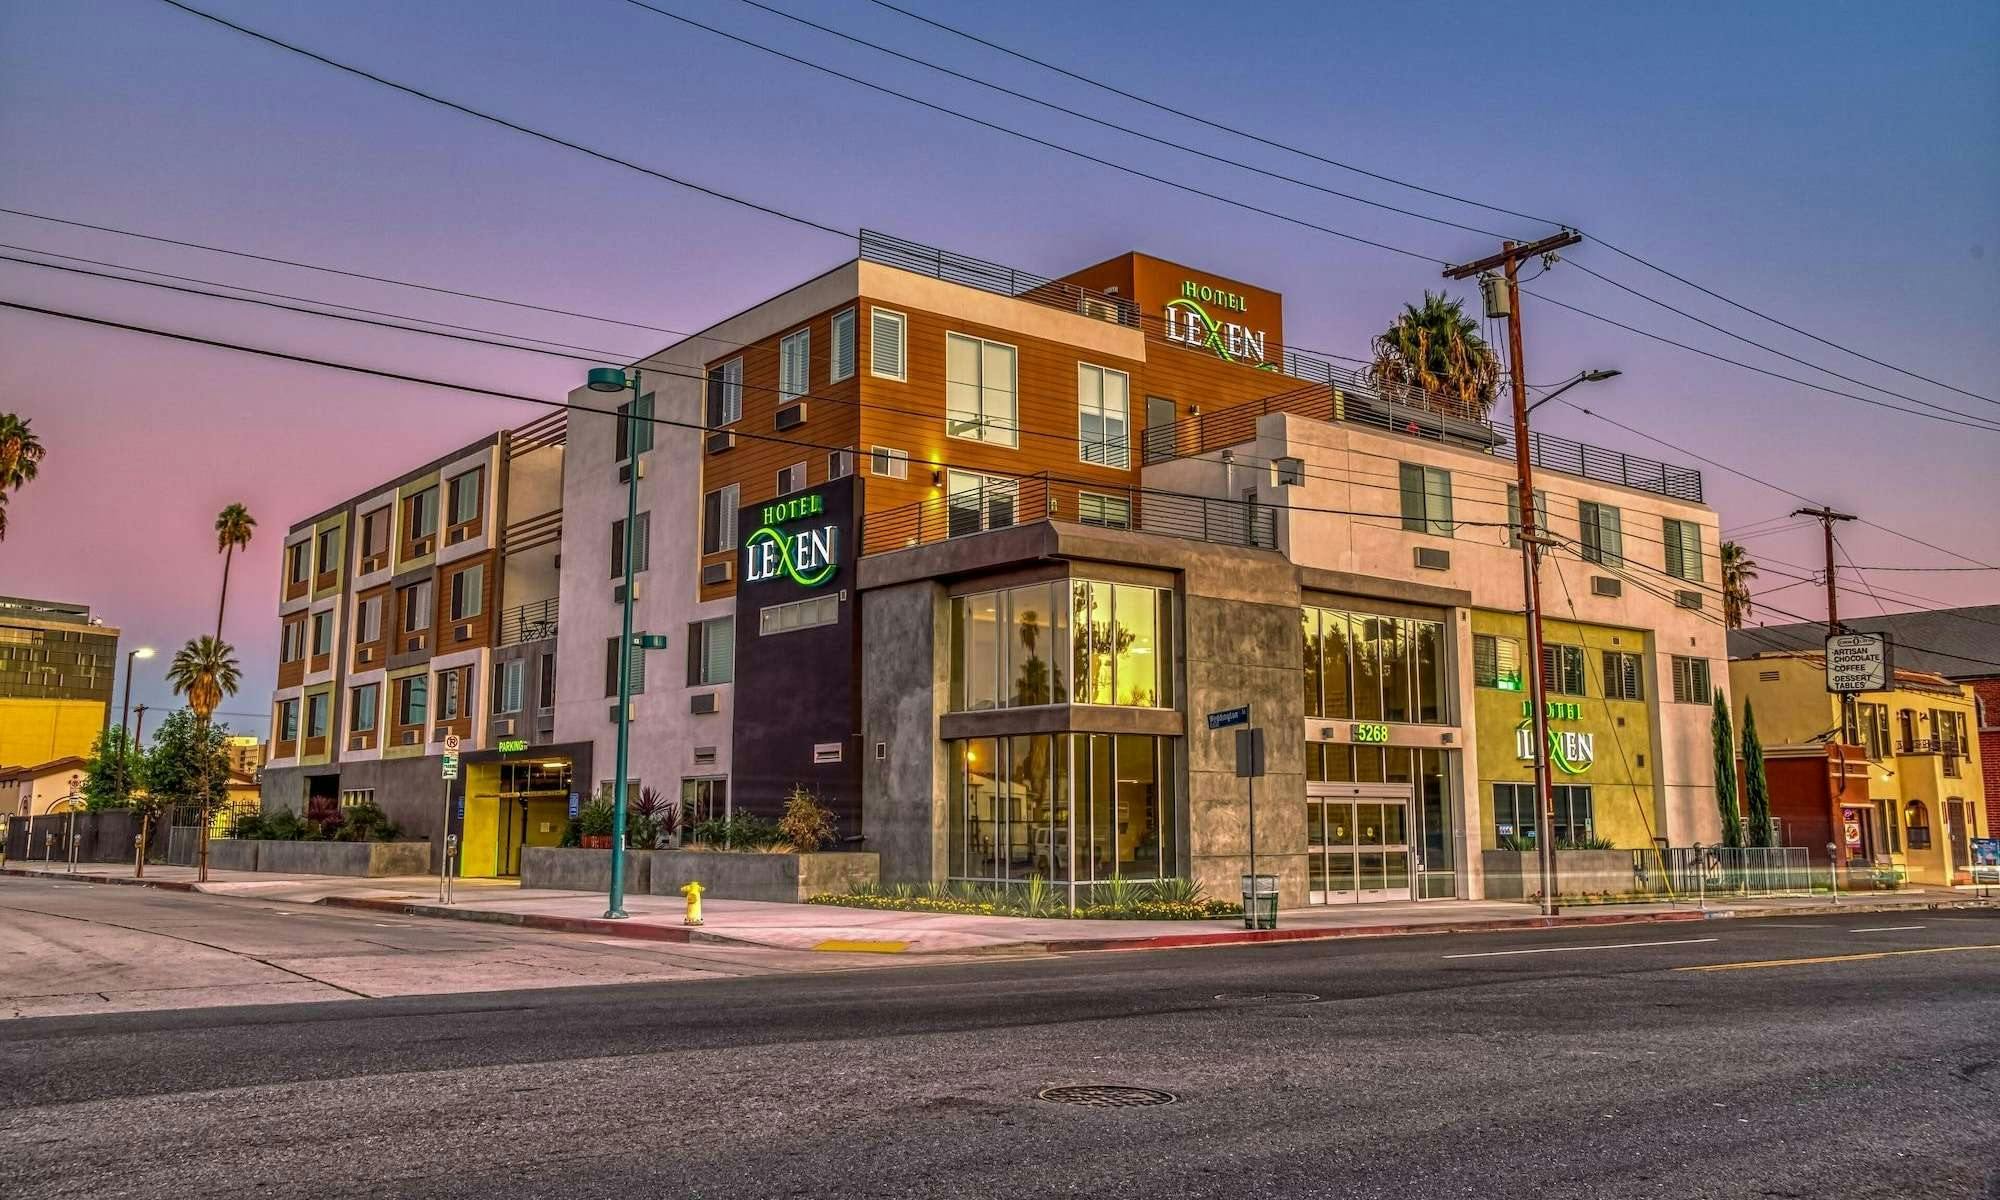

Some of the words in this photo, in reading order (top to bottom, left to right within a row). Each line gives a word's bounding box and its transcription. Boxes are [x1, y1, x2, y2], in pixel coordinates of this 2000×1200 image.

[1182, 280, 1248, 312] HOTEL
[1165, 299, 1266, 362] LEXEN
[764, 495, 823, 525] HOTEL
[746, 527, 837, 585] LEXEN
[1834, 648, 1868, 656] ARTISAN
[1834, 654, 1880, 663] CHOCOLATE
[1834, 664, 1866, 672] COFFEE
[1834, 674, 1872, 682] DESSERT
[1358, 724, 1388, 742] 5268
[498, 741, 524, 752] PARKING
[1516, 723, 1593, 773] LXEN
